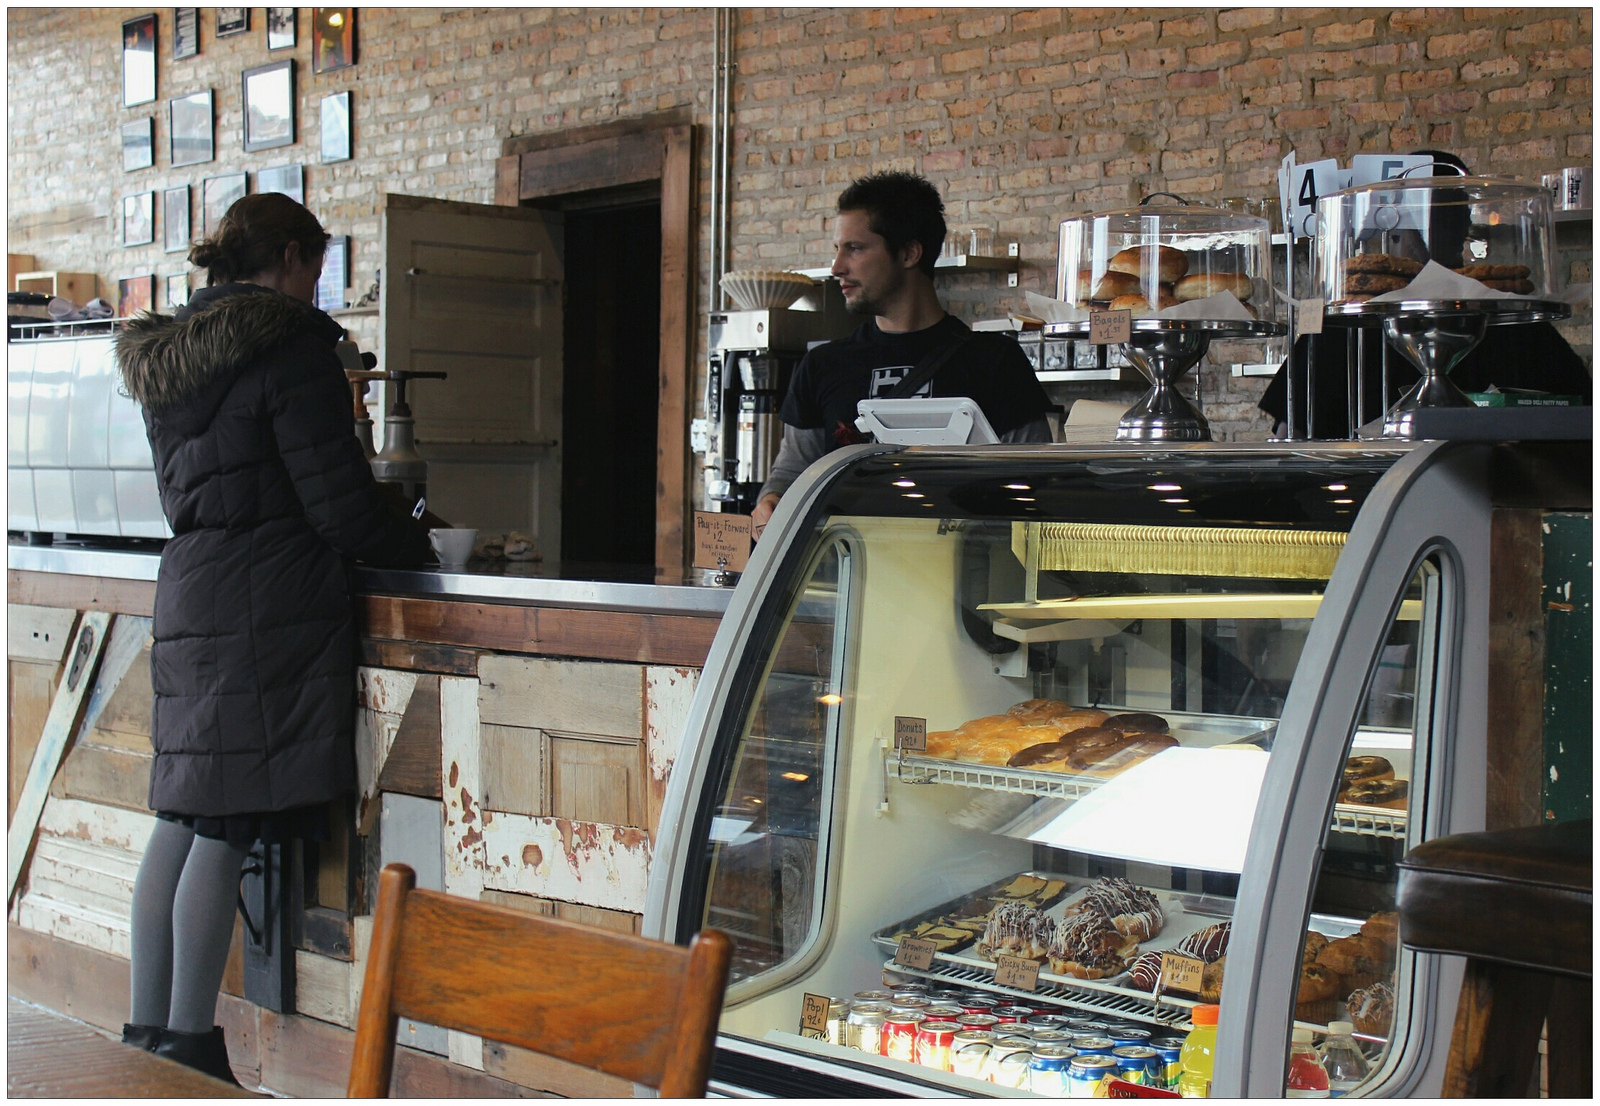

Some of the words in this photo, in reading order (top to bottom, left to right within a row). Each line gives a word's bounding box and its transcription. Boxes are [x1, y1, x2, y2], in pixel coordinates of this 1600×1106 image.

[1298, 168, 1320, 213] 4
[1093, 314, 1126, 327] Bagels
[697, 516, 750, 535] Pay-it-Forward
[897, 719, 923, 733] Donuts
[902, 939, 932, 954] Brownies
[1000, 957, 1020, 972] Sticky
[1021, 961, 1037, 972] Buns
[1166, 957, 1200, 973] Muffins
[807, 998, 825, 1017] Pop!
